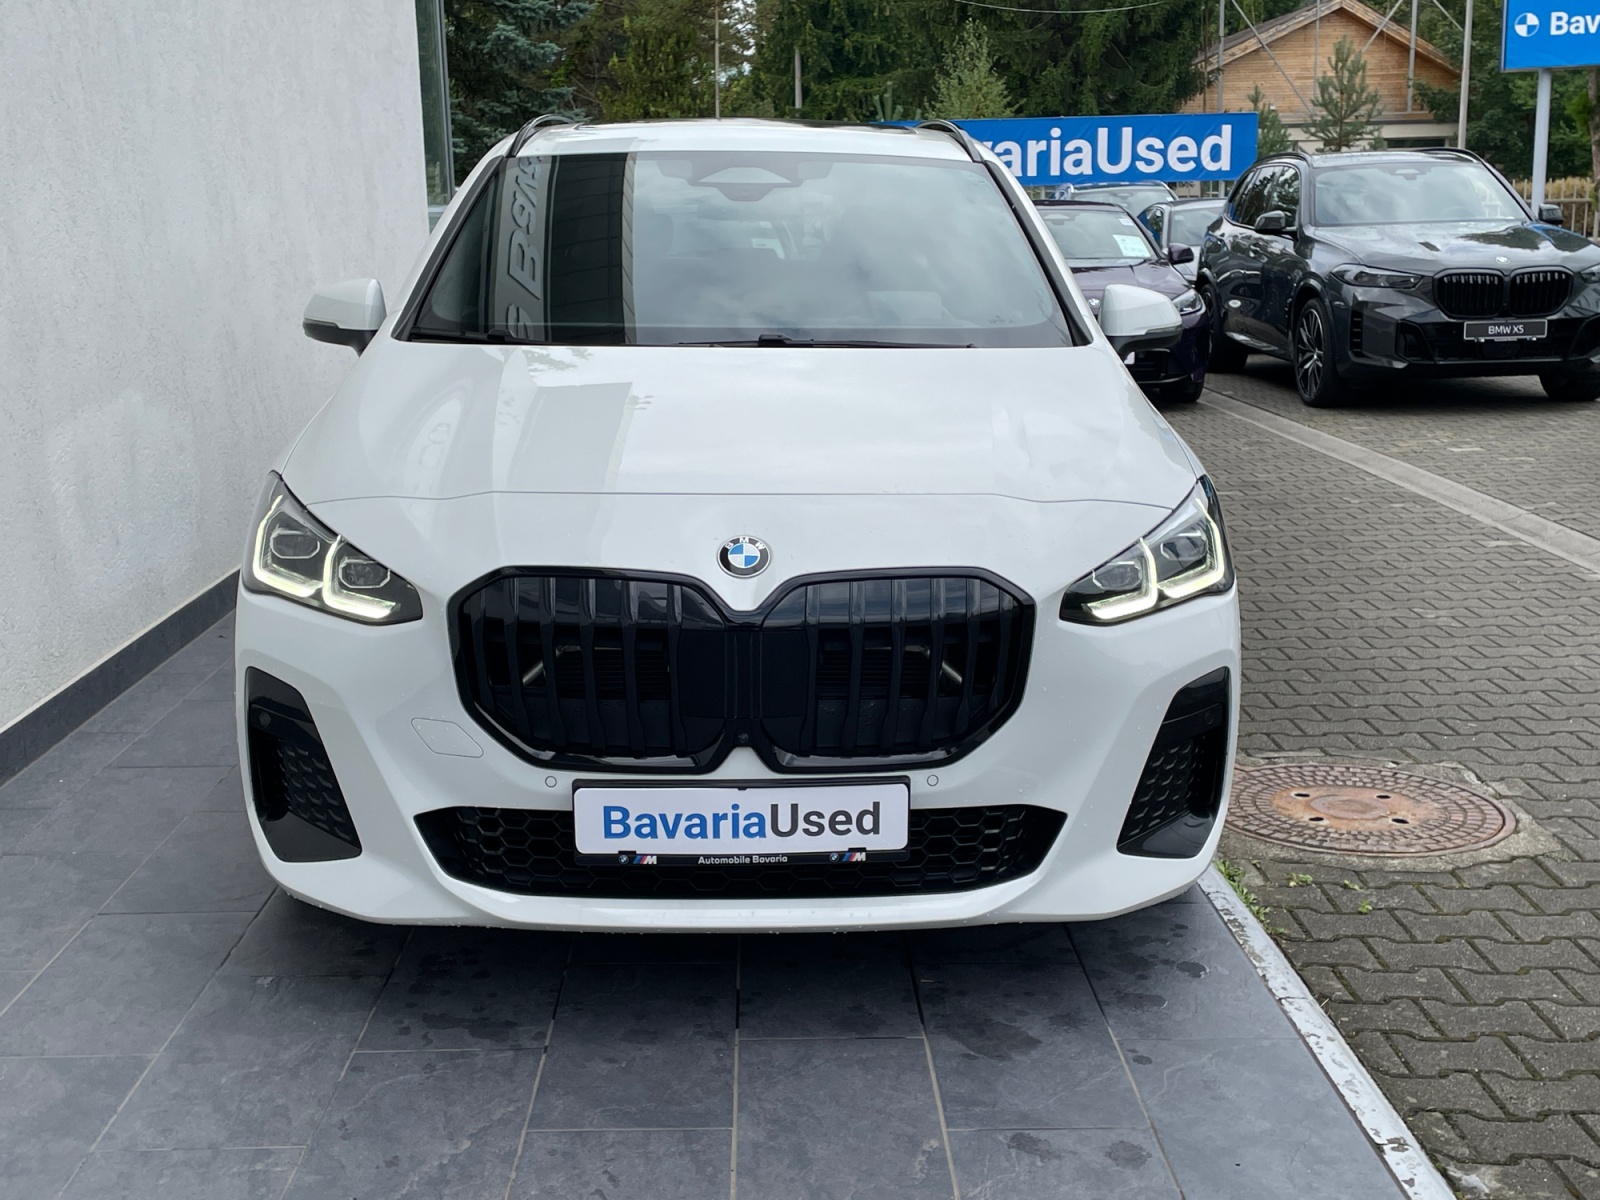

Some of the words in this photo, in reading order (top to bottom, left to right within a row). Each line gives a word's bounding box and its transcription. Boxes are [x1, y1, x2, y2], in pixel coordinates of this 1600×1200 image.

[1550, 11, 1600, 35] Bav
[982, 124, 1232, 177] ariaUsed
[1488, 325, 1511, 334] BMW
[1512, 325, 1524, 334] X5
[725, 536, 765, 550] BMW
[603, 801, 881, 839] BavariaUsed
[698, 856, 751, 865] Automobile
[752, 855, 788, 864] Bavaria
